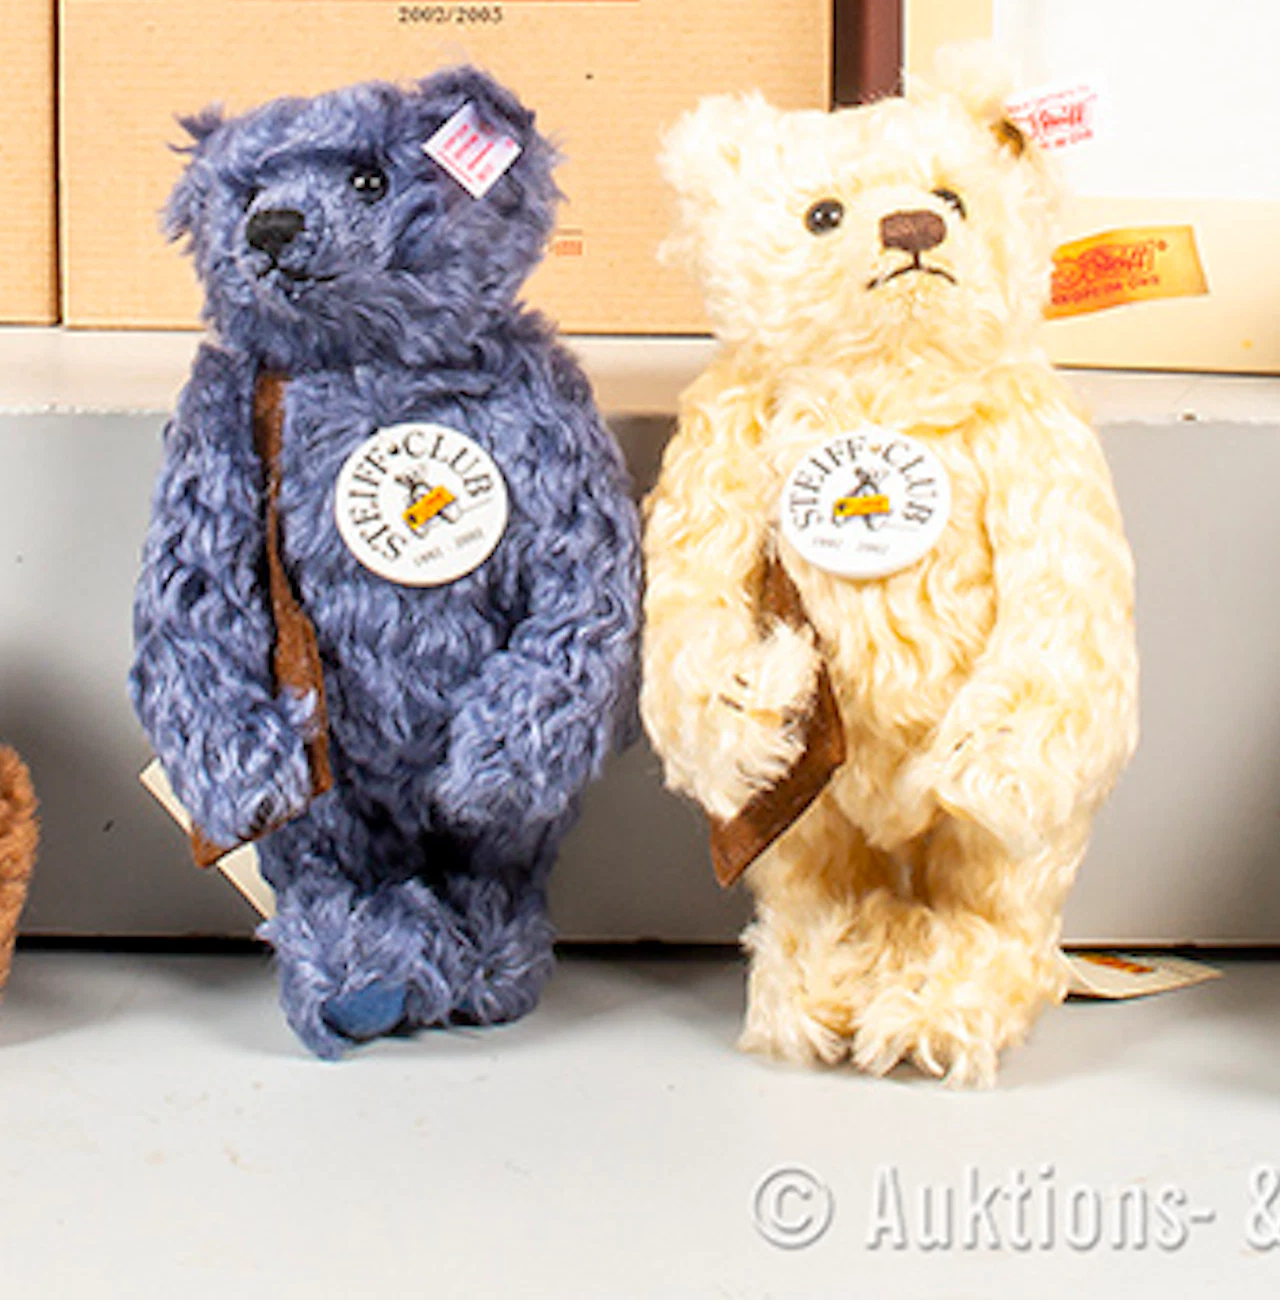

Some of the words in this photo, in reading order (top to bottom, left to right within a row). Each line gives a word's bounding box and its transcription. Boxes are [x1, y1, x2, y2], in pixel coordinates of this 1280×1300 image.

[349, 446, 407, 562] STEIFF
[402, 430, 493, 497] CLUB
[790, 435, 867, 530] STEIFF
[882, 440, 938, 524] CLUB
